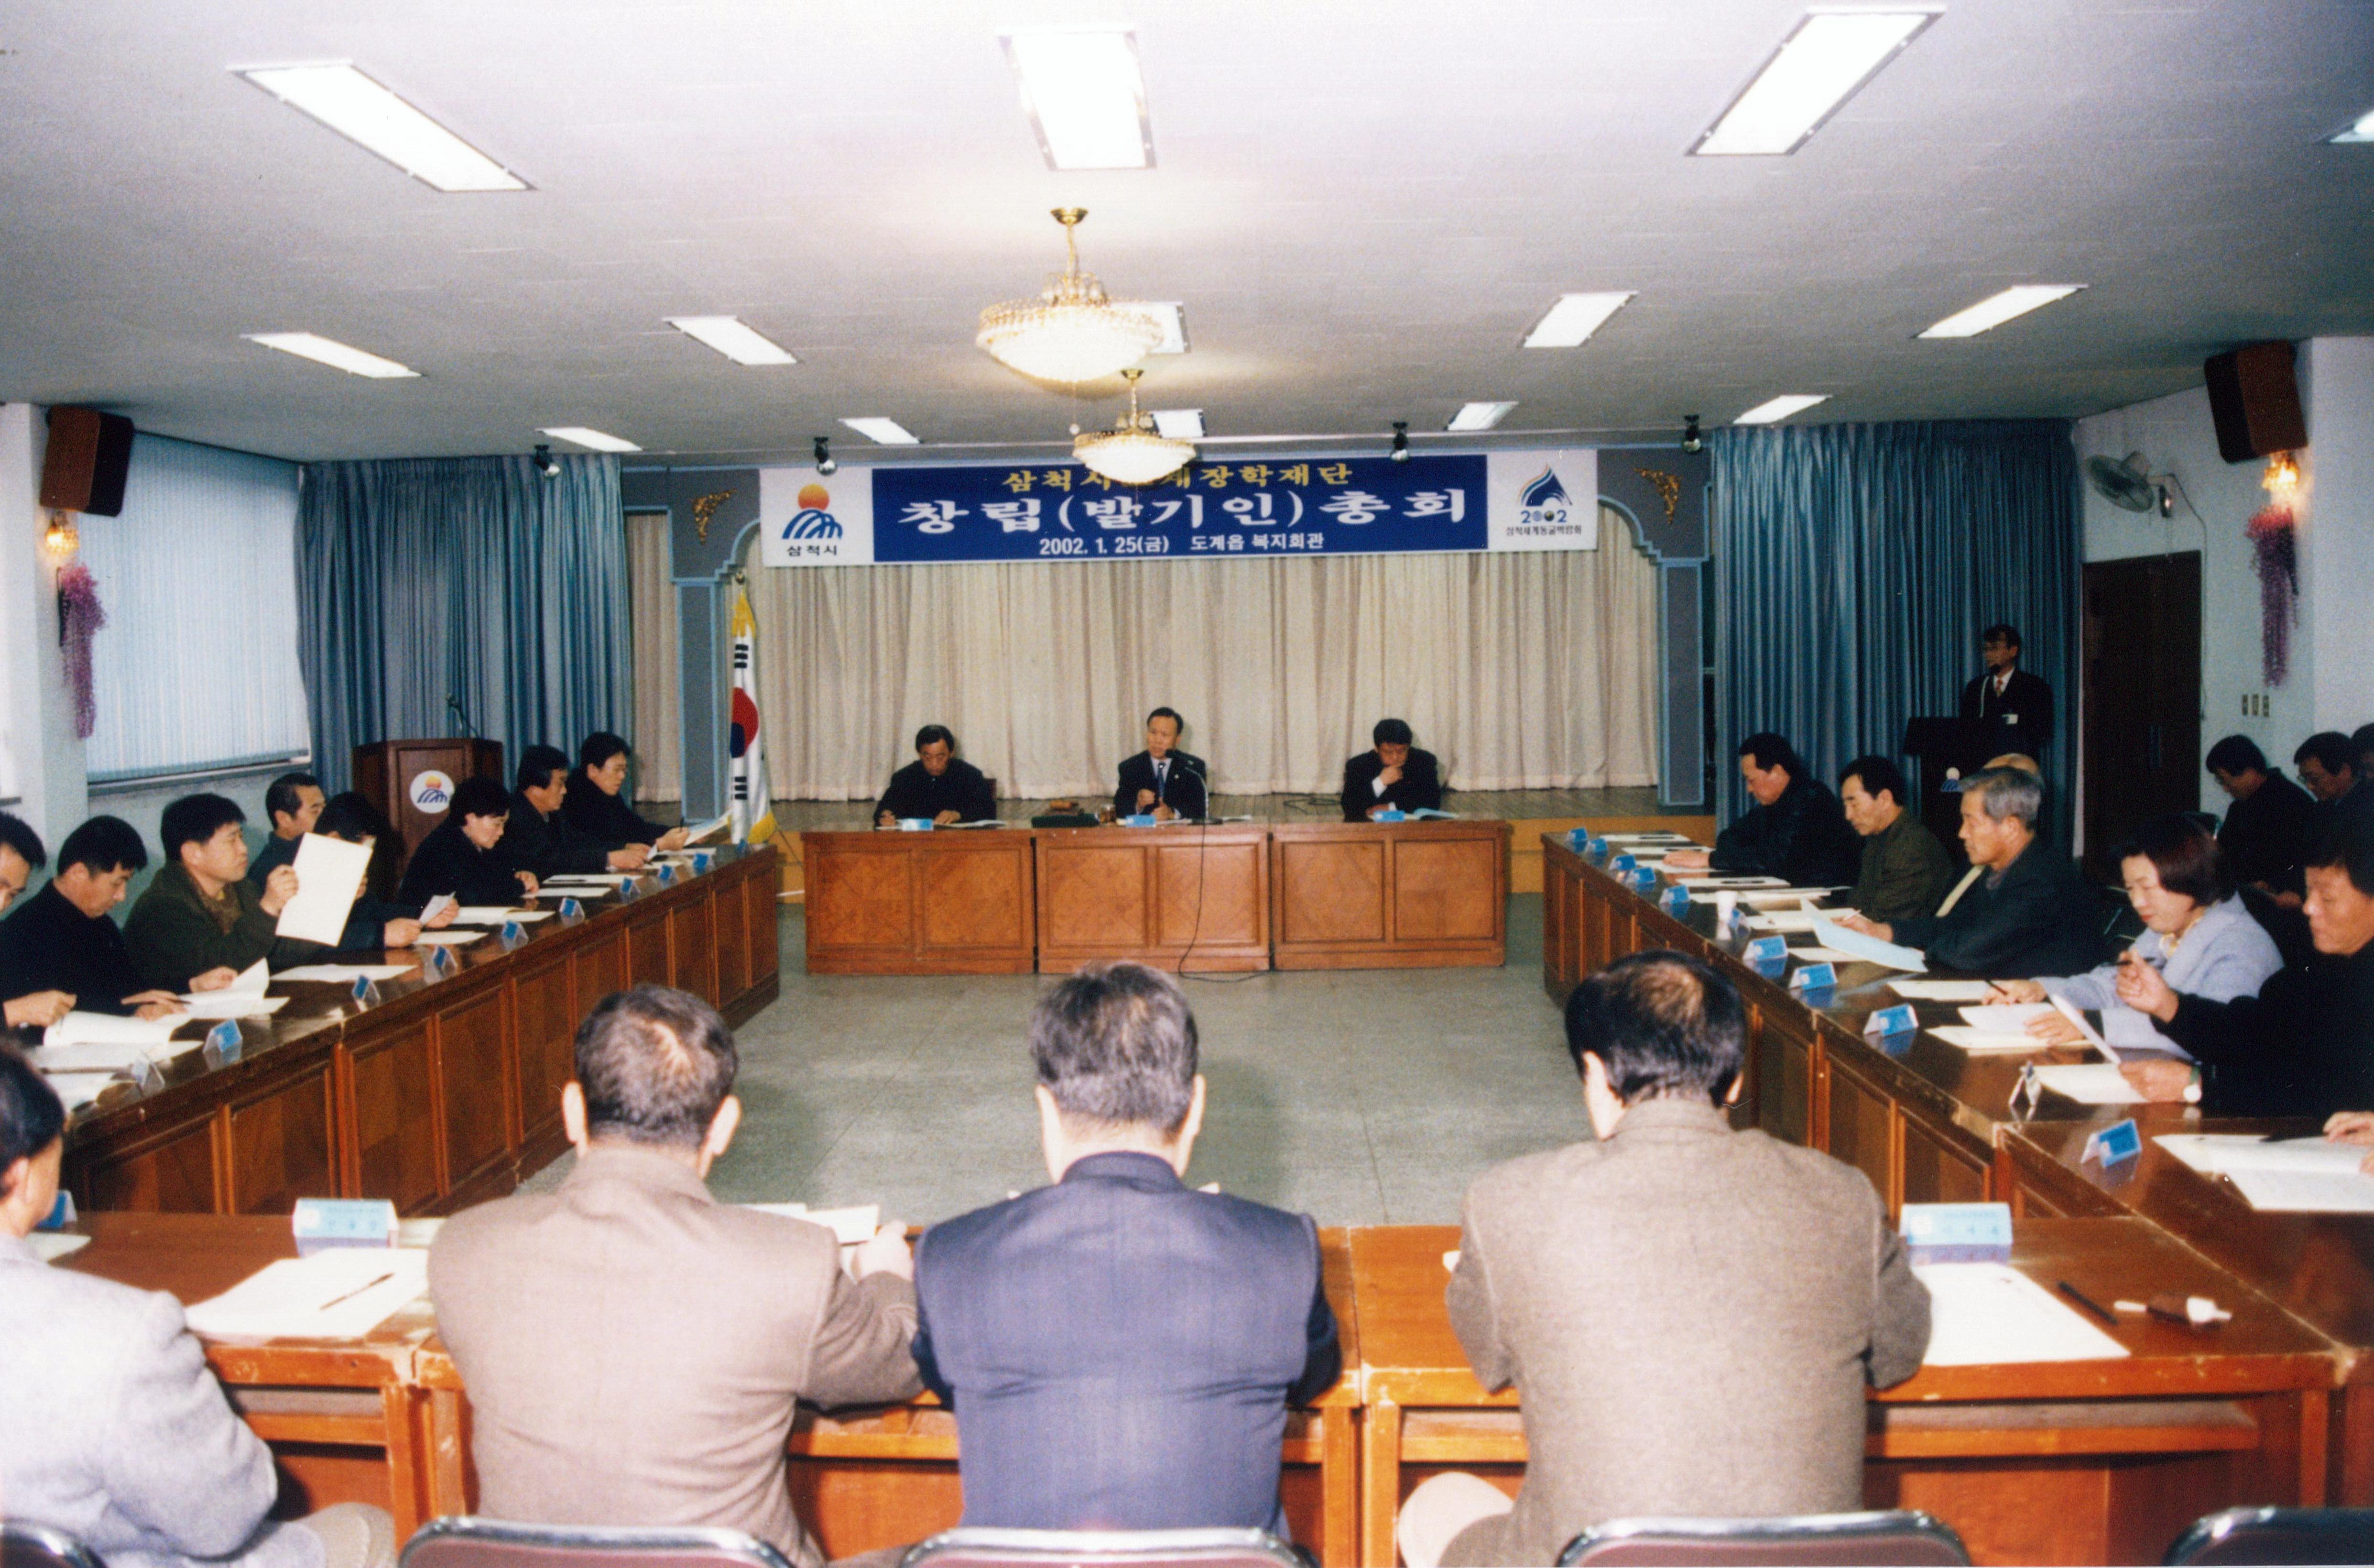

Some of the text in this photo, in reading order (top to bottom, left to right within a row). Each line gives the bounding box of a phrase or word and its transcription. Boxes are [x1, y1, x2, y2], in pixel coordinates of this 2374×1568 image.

[787, 545, 837, 556] 삼척시
[1115, 535, 1169, 554] 25(금)
[1190, 534, 1245, 551] 도계읍
[1252, 532, 1325, 550] 복지회관
